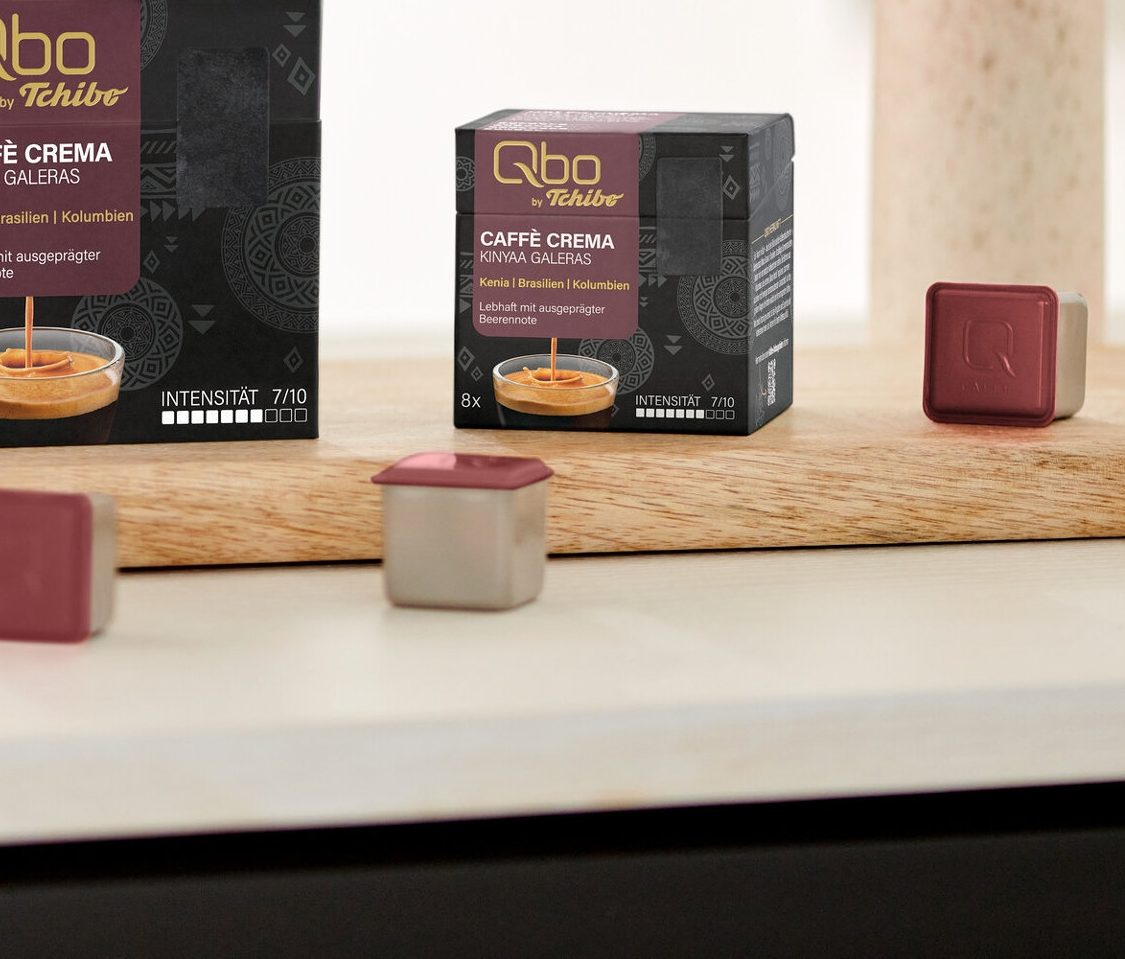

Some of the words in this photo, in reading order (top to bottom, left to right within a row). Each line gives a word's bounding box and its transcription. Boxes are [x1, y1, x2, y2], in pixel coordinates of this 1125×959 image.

[0, 97, 14, 110] by
[19, 82, 128, 107] Tchibo
[25, 143, 112, 163] CREMA
[494, 141, 600, 188] Qbo
[4, 168, 80, 185] GALERAS
[532, 198, 542, 207] by
[546, 189, 624, 207] Tchibo
[62, 210, 133, 222] Kolumbien
[481, 229, 540, 247] CAFFÈ
[547, 233, 614, 249] CREMA
[16, 249, 100, 264] ausgeprägter
[481, 251, 526, 263] KINYAA
[531, 252, 591, 265] GALERAS
[480, 278, 509, 287] Kenia
[519, 278, 564, 288] Brasilien
[573, 280, 629, 290] Kolumbien
[480, 302, 517, 311] Lebhaft
[520, 303, 536, 312] mit
[539, 304, 605, 316] ausgeprägter
[480, 314, 537, 324] Beerennote
[162, 387, 258, 406] INTENSITÄT
[273, 389, 306, 404] 7/10
[462, 393, 480, 407] 8x
[635, 394, 701, 407] INTENSITÄT
[711, 397, 734, 407] 7/10
